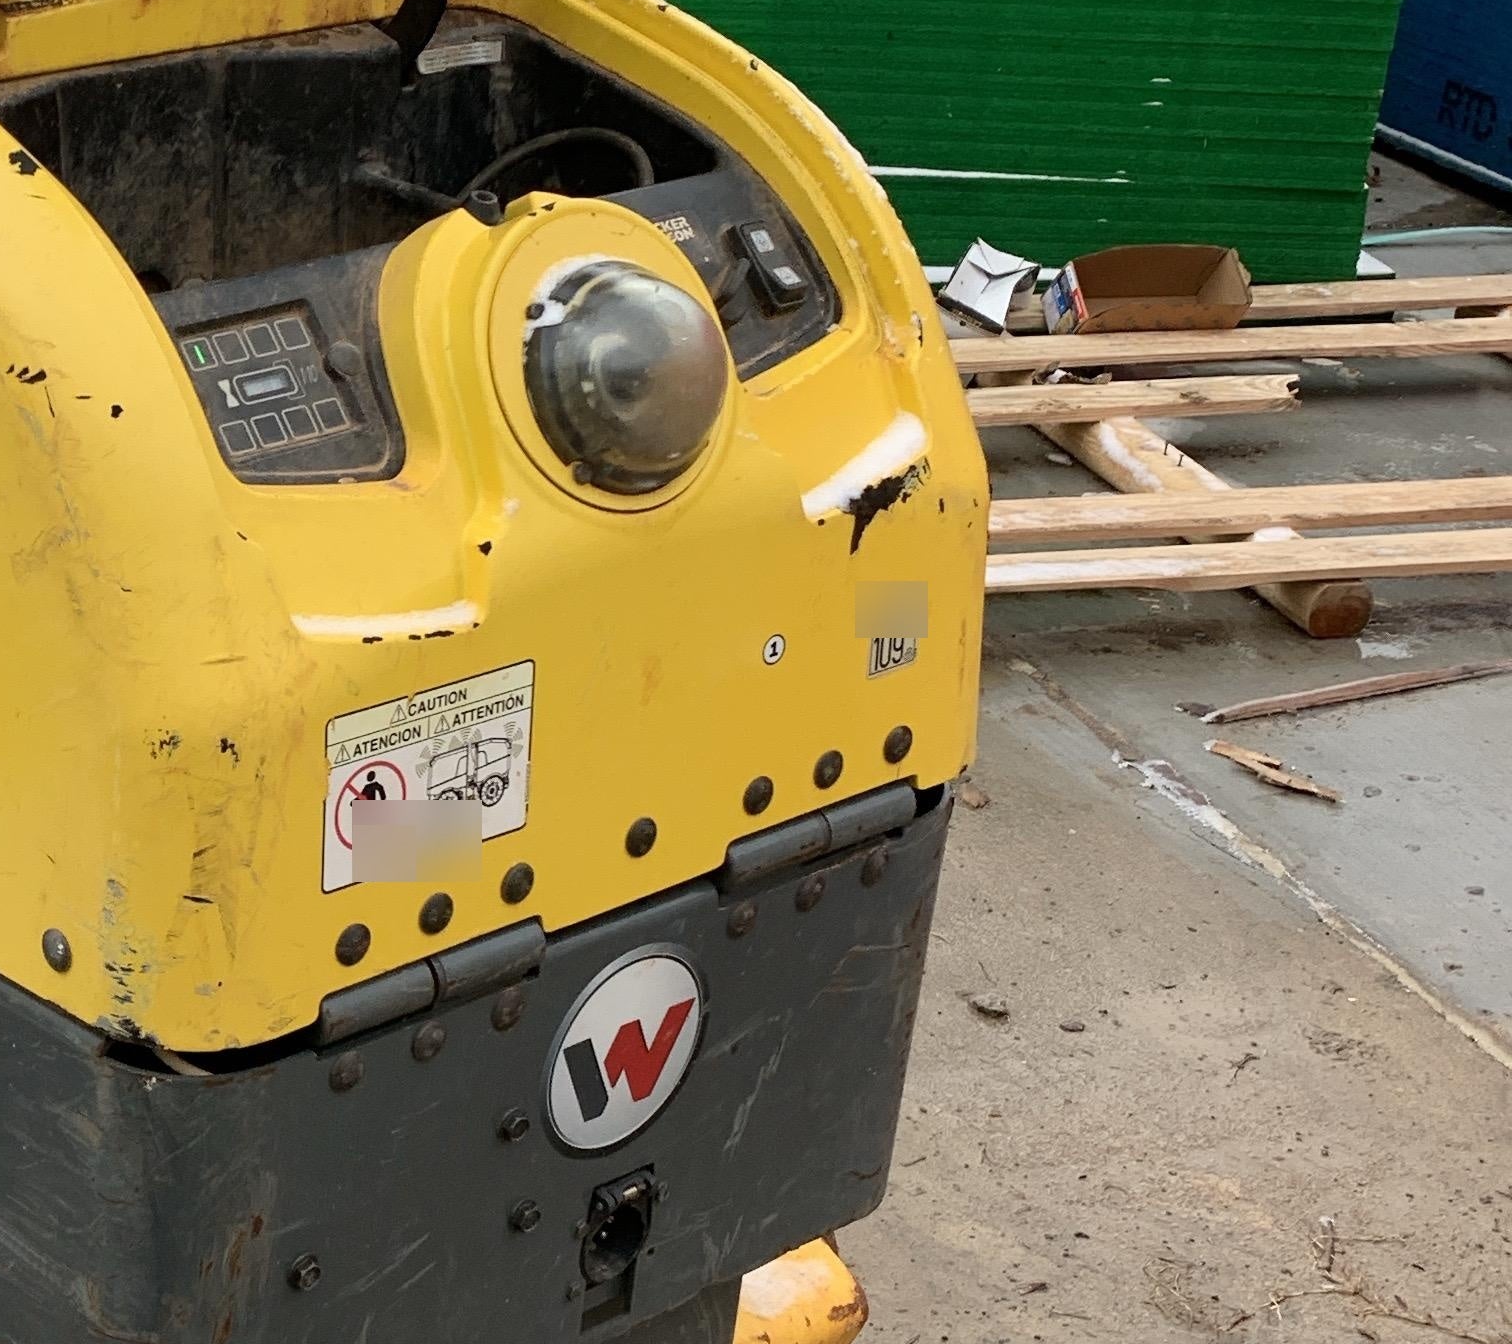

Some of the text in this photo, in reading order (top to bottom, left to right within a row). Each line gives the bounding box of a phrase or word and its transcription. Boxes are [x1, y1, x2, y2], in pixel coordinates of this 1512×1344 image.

[769, 641, 779, 658] 1
[407, 688, 468, 717] CAUTION
[452, 694, 525, 727] ATTENTION
[352, 725, 422, 757] ATENCION
